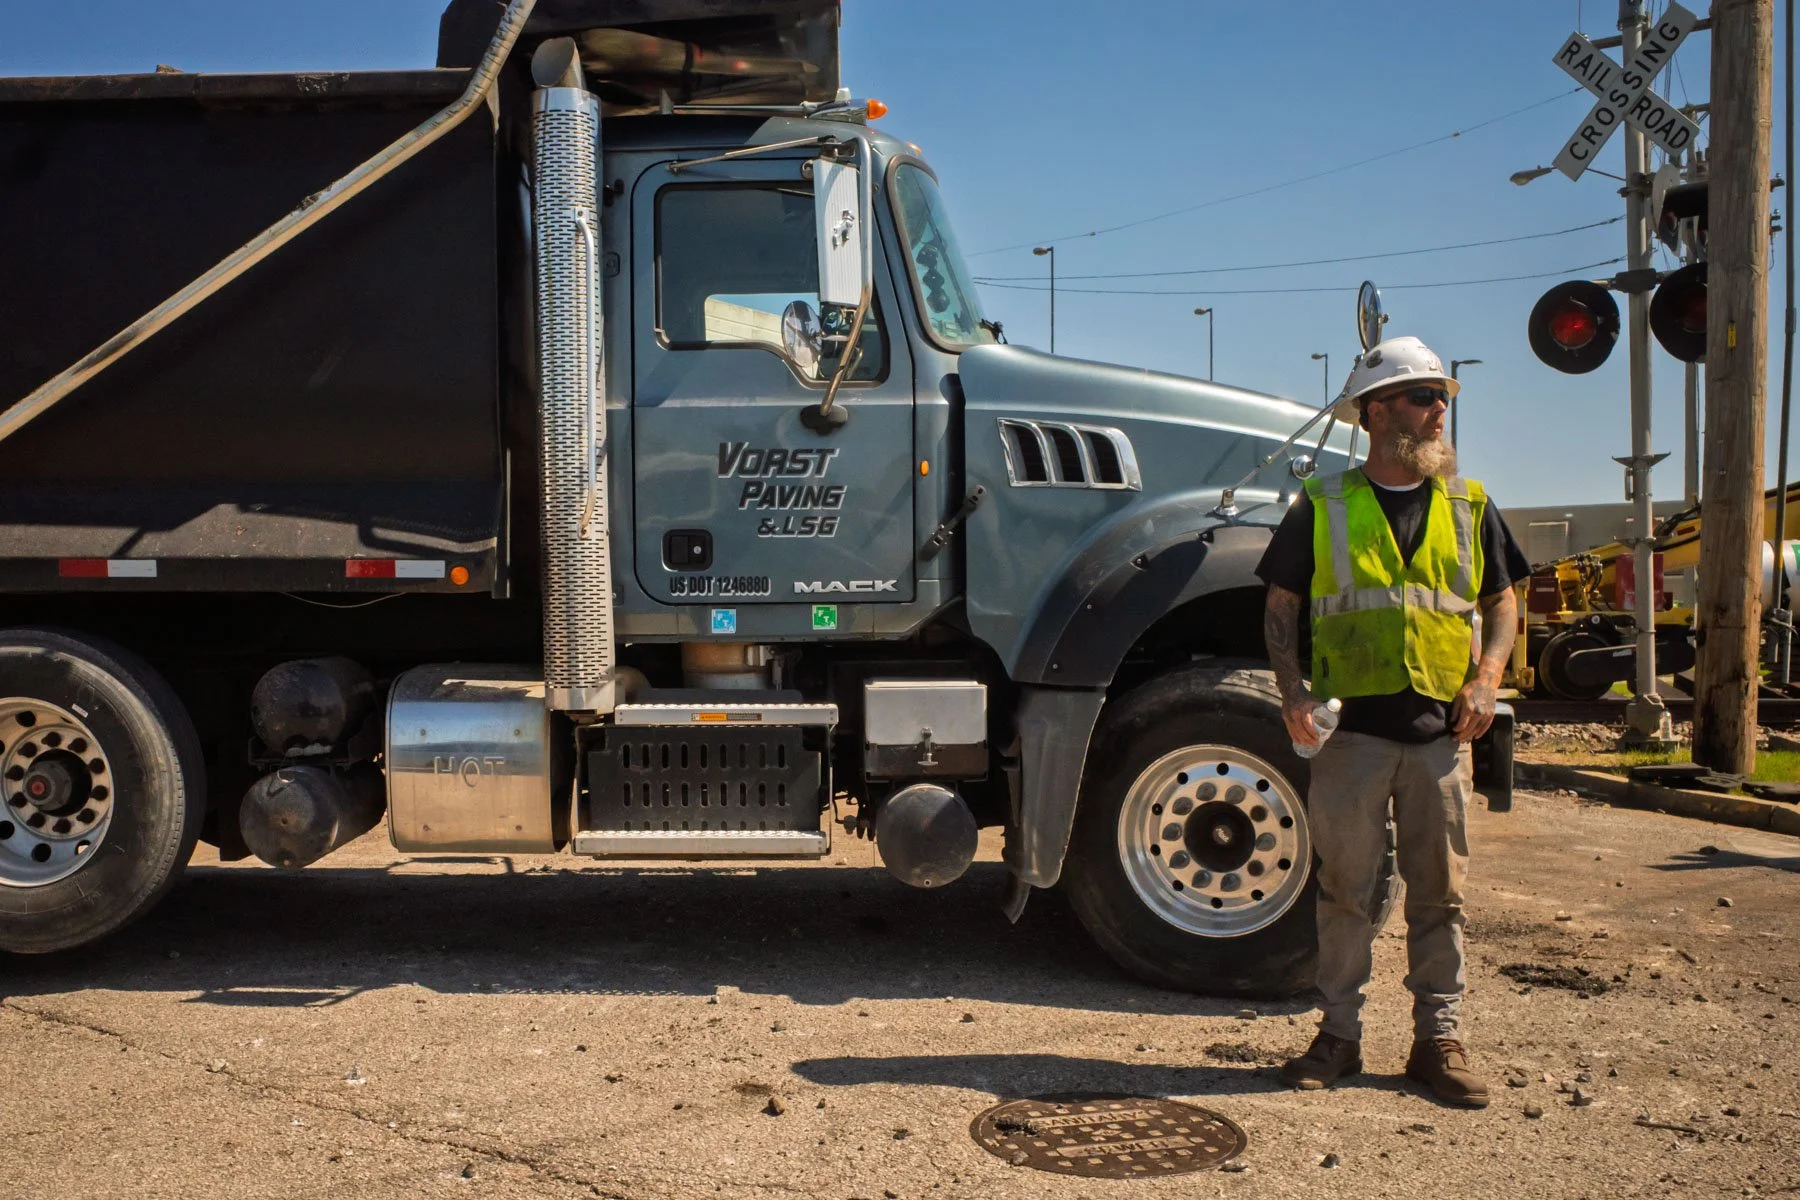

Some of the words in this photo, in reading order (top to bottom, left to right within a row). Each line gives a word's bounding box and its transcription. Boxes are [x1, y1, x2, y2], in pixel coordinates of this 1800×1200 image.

[1560, 40, 1611, 92] RAIL
[1630, 95, 1690, 149] ROAD
[1569, 22, 1680, 161] CROSSING
[717, 441, 840, 478] VORST
[738, 480, 847, 510] PAVING
[670, 576, 688, 596] US
[689, 576, 716, 596] DOT
[717, 576, 771, 596] 1246880
[794, 580, 898, 593] MACK
[433, 755, 505, 788] HOT
